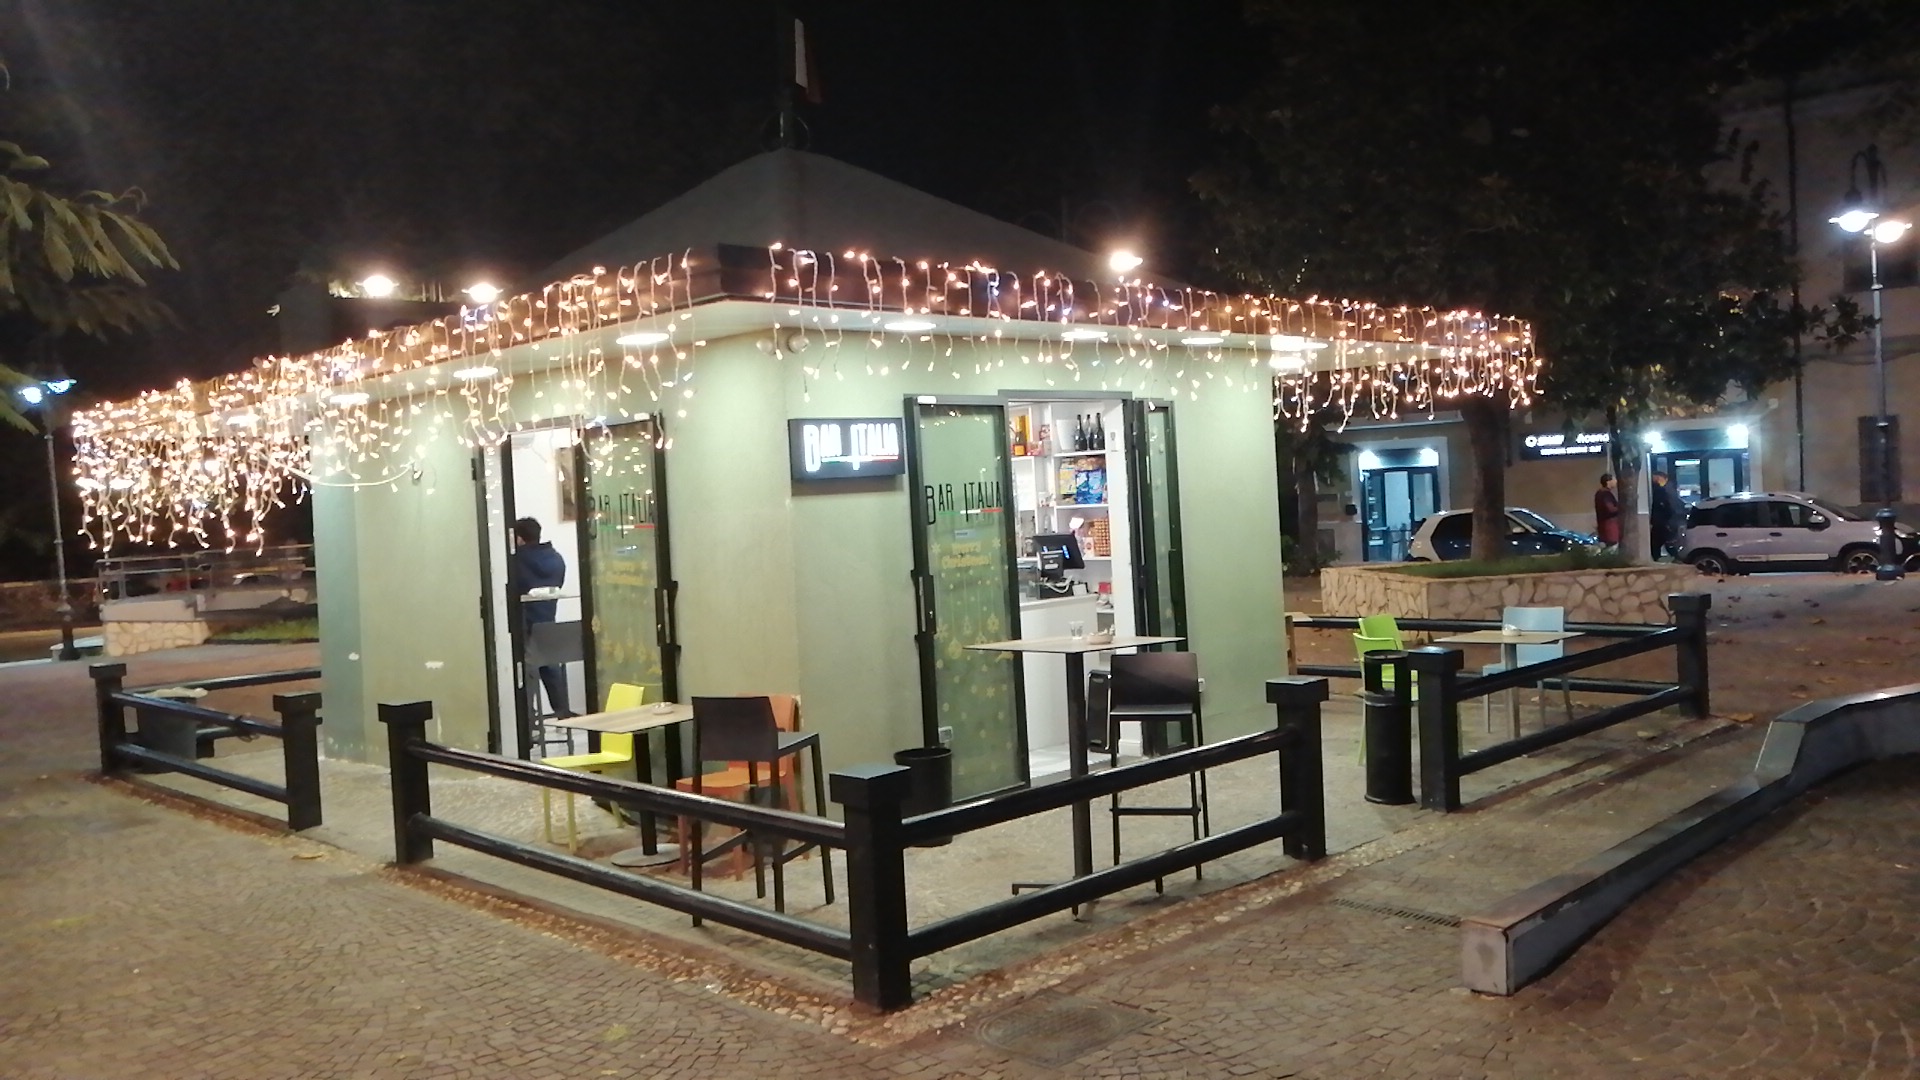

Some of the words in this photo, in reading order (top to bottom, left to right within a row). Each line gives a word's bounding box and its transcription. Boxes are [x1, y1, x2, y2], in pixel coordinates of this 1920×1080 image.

[803, 424, 842, 472] BAR
[850, 422, 899, 470] ITALIA
[924, 483, 954, 525] BAR
[963, 481, 1002, 522] ITALIA
